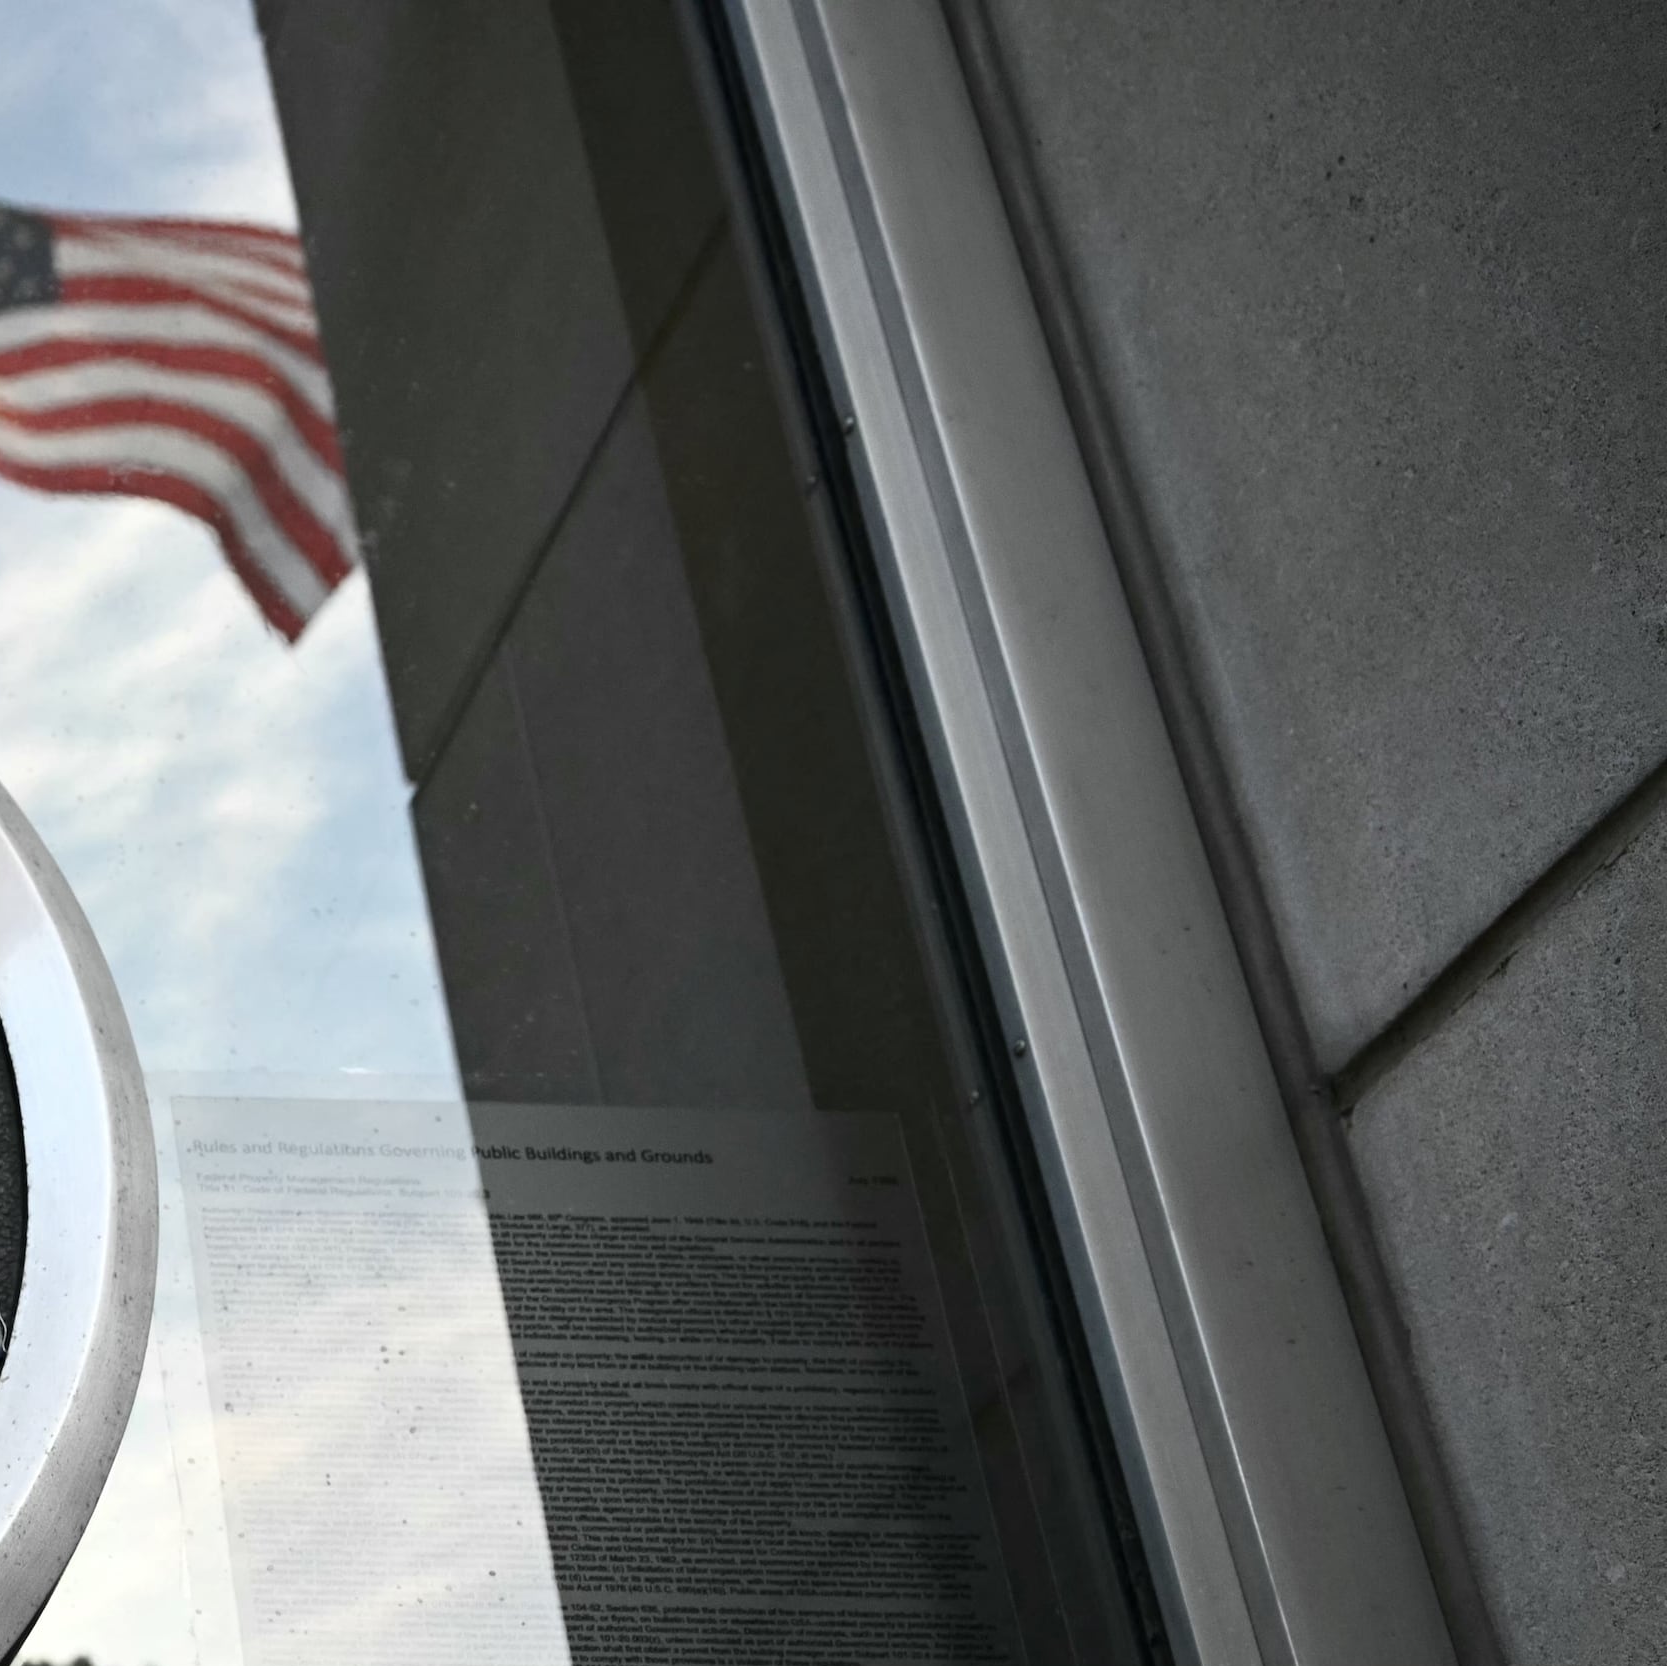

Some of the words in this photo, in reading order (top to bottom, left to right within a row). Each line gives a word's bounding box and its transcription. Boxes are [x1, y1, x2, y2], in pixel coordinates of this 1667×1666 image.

[192, 1139, 238, 1154] Rules
[241, 1140, 273, 1155] and
[378, 1142, 465, 1162] Governing
[524, 1145, 601, 1164] Buildings
[605, 1146, 636, 1162] and
[640, 1147, 714, 1163] Grounds
